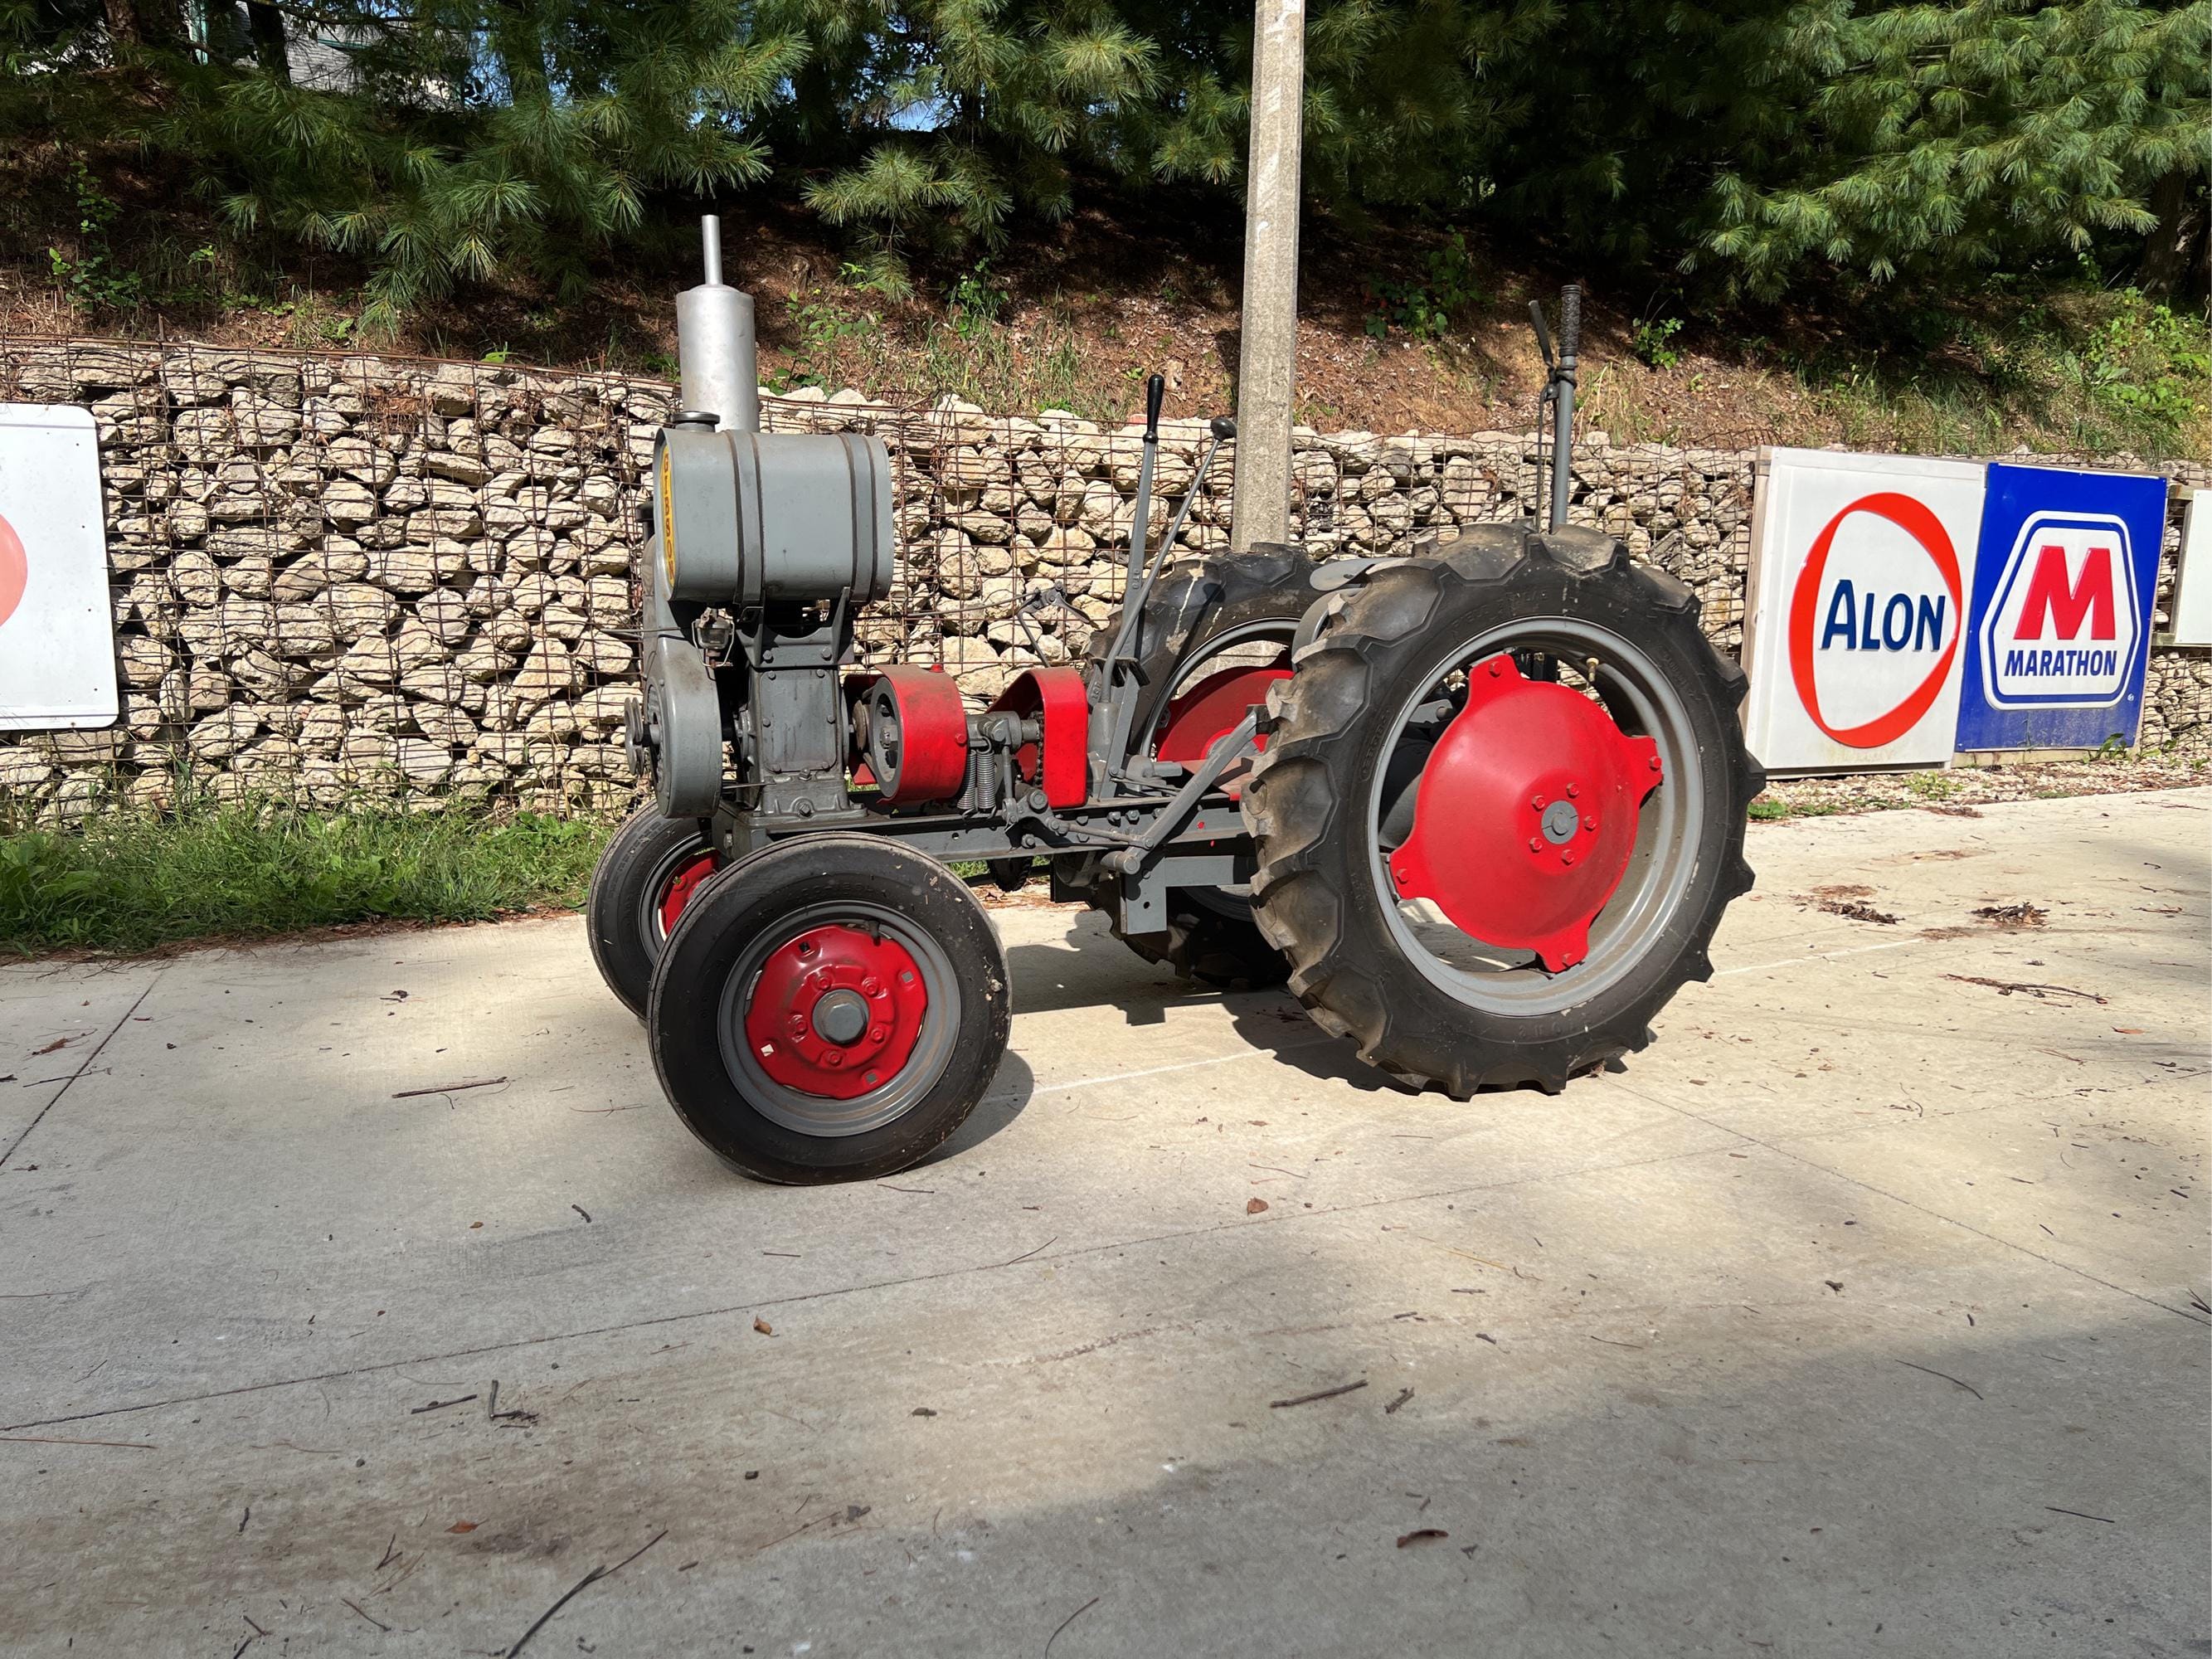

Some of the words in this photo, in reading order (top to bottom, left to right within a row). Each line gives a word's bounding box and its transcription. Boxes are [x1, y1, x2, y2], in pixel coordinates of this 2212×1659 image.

[664, 454, 674, 580] GIBSON
[1820, 579, 1946, 651] ALON
[2013, 546, 2116, 640] M
[2004, 649, 2117, 677] MARATHON
